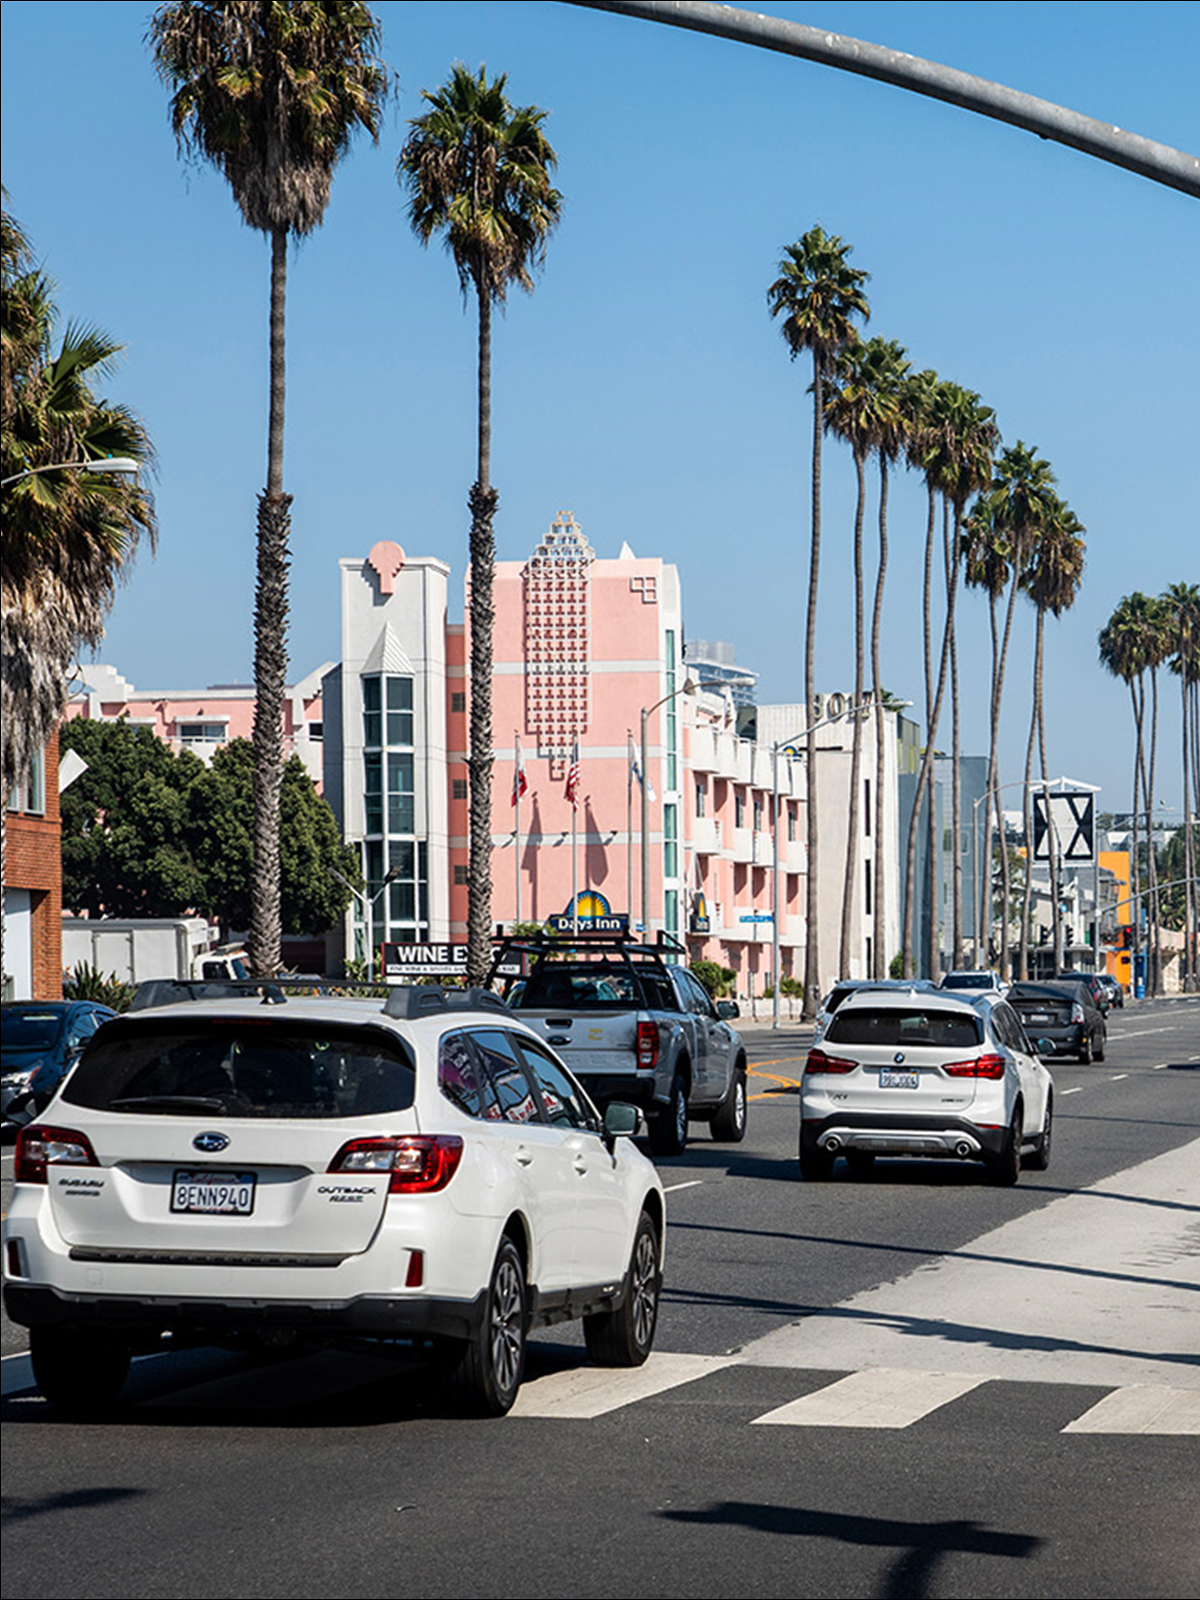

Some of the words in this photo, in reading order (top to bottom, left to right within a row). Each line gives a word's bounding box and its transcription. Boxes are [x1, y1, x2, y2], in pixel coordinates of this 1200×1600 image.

[558, 918, 593, 931] Days
[595, 918, 621, 930] Inn
[397, 946, 448, 963] WINE
[58, 1178, 105, 1188] SUBARU
[177, 1186, 249, 1207] 8ENN940
[317, 1185, 377, 1195] OUTBACK
